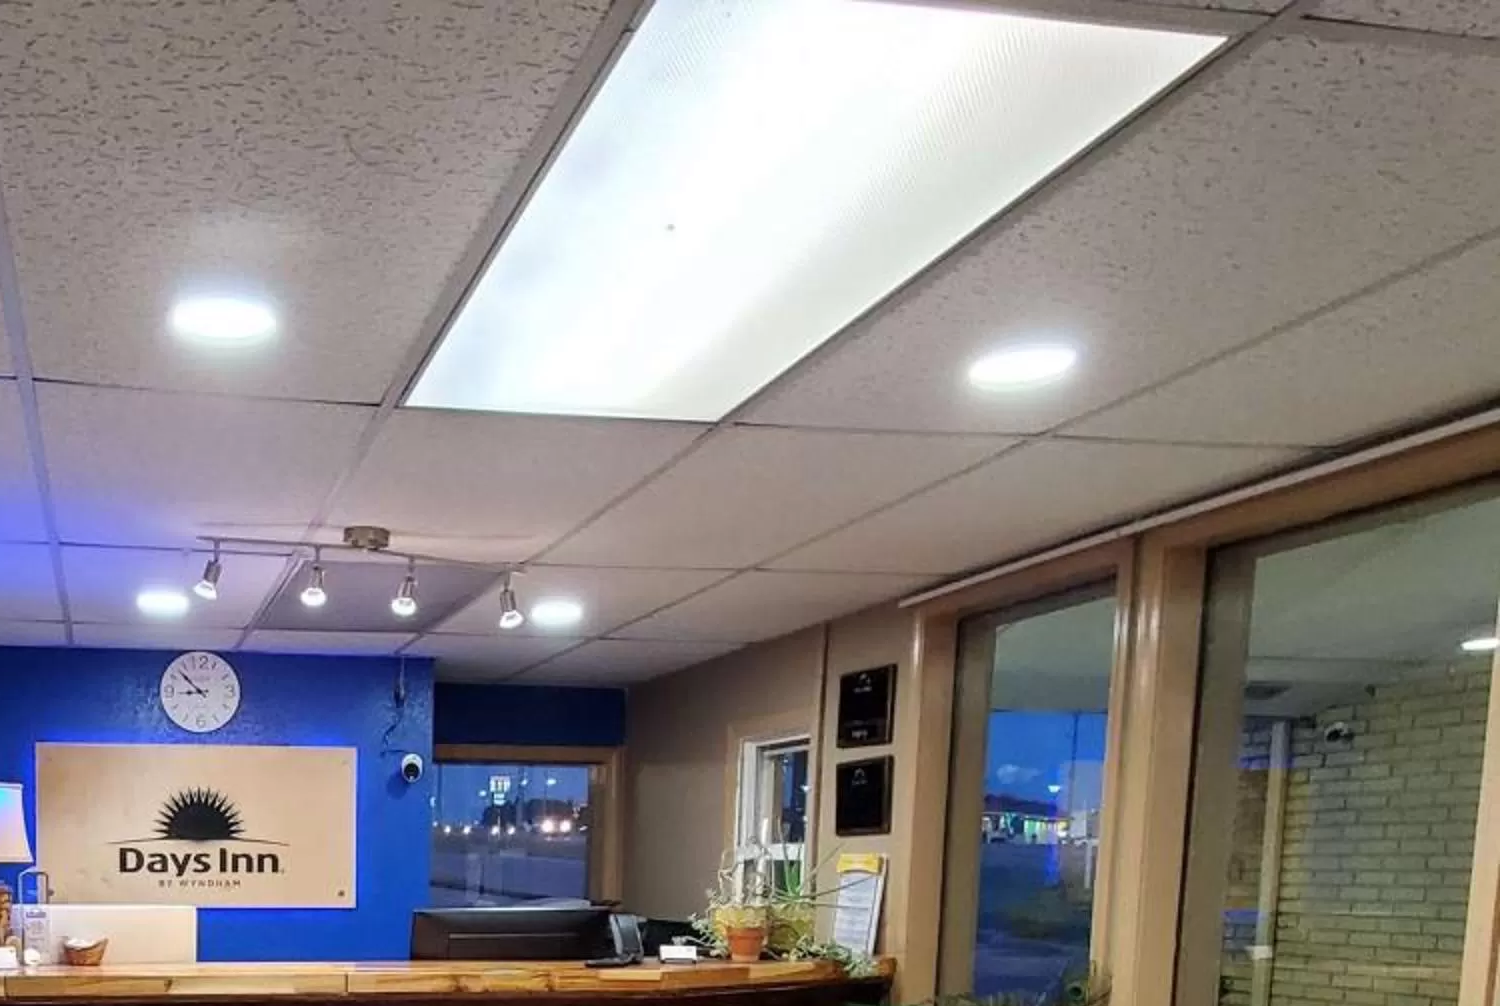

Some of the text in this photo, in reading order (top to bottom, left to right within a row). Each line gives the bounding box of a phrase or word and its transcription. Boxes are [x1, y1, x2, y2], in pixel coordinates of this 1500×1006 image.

[191, 655, 209, 670] 12
[223, 684, 236, 699] 3
[118, 847, 280, 877] Days Inn
[179, 879, 242, 888] WYNDHAM
